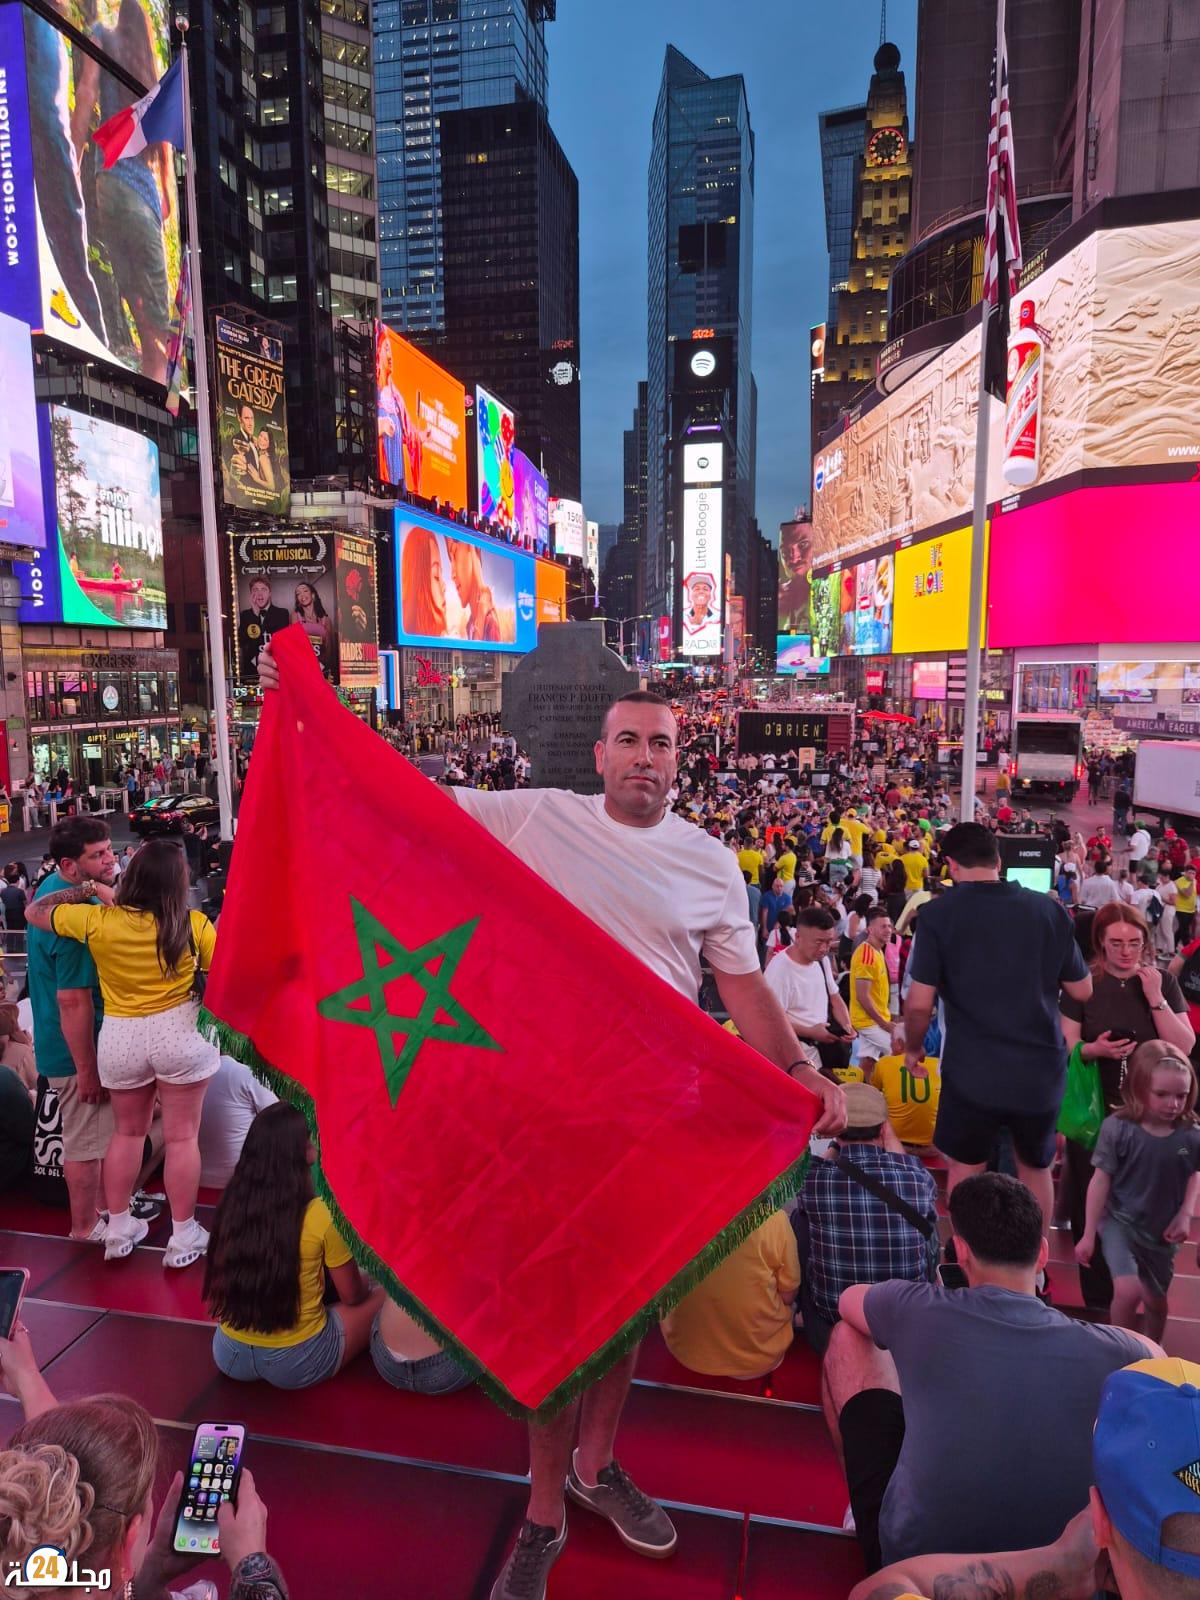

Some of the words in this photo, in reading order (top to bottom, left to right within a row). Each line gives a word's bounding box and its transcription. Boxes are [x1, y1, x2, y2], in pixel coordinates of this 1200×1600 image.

[218, 352, 242, 380] THE
[244, 364, 284, 394] GREAT
[228, 378, 278, 409] GATSBY
[696, 492, 710, 536] Boogie
[253, 549, 275, 561] BEST
[275, 548, 314, 561] MUSICAL
[696, 538, 707, 568] Little
[82, 653, 138, 669] EXPRESS
[528, 692, 568, 703] FRANCIS
[580, 692, 613, 703] DUFFY
[1126, 720, 1166, 731] AMERICAN
[1168, 722, 1195, 734] EAGLE
[87, 734, 107, 743] GIFTS
[900, 1066, 931, 1104] 10
[34, 1165, 46, 1176] SOL
[48, 1168, 60, 1177] DEL
